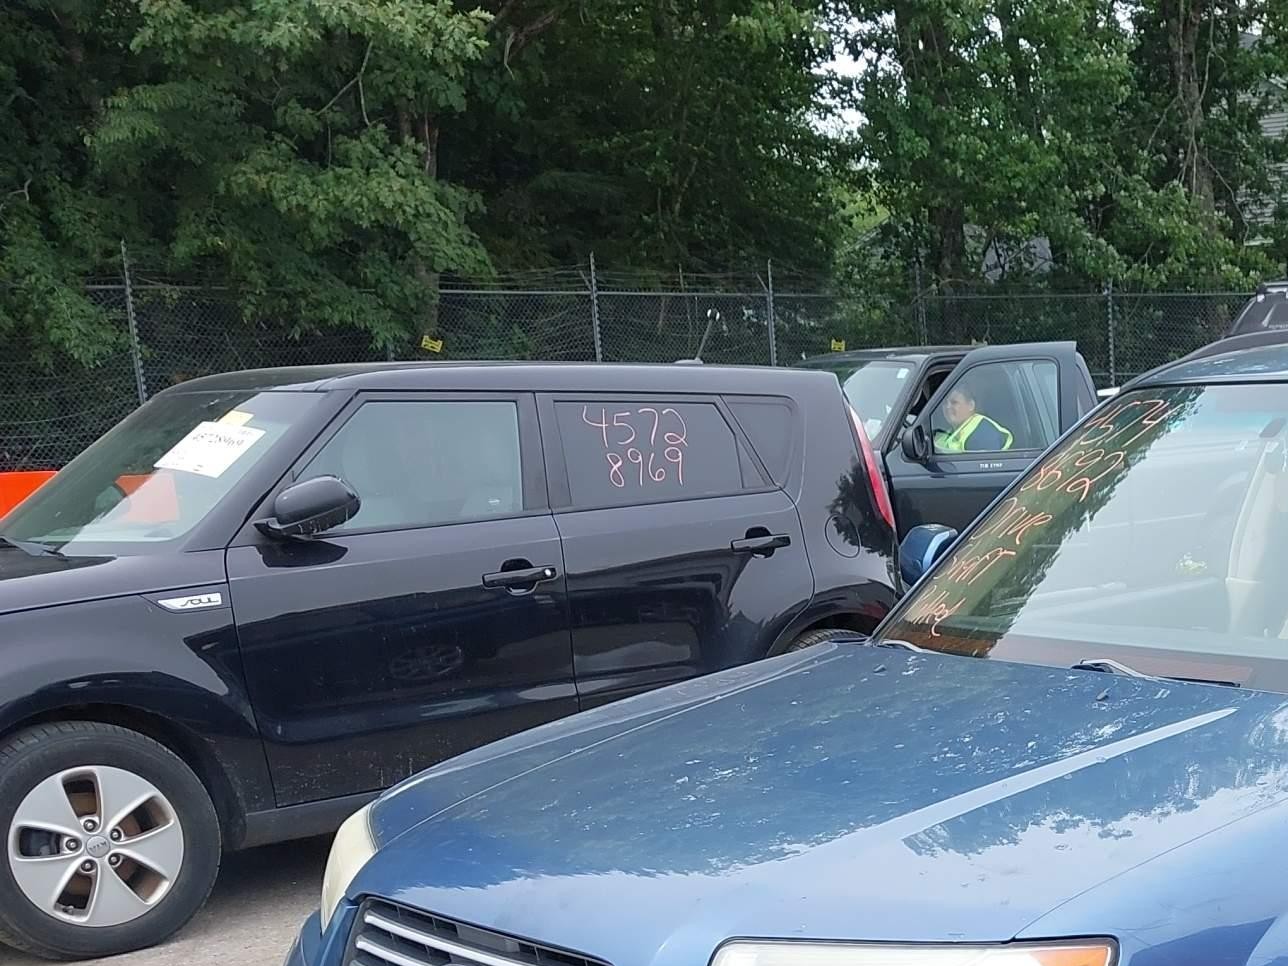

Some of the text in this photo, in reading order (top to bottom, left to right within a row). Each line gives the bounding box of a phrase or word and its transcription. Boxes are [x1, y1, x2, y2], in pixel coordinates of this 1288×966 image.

[582, 404, 689, 448] 4572
[1070, 399, 1185, 452] 4574
[606, 446, 684, 488] 8969
[1020, 448, 1127, 503] 8692
